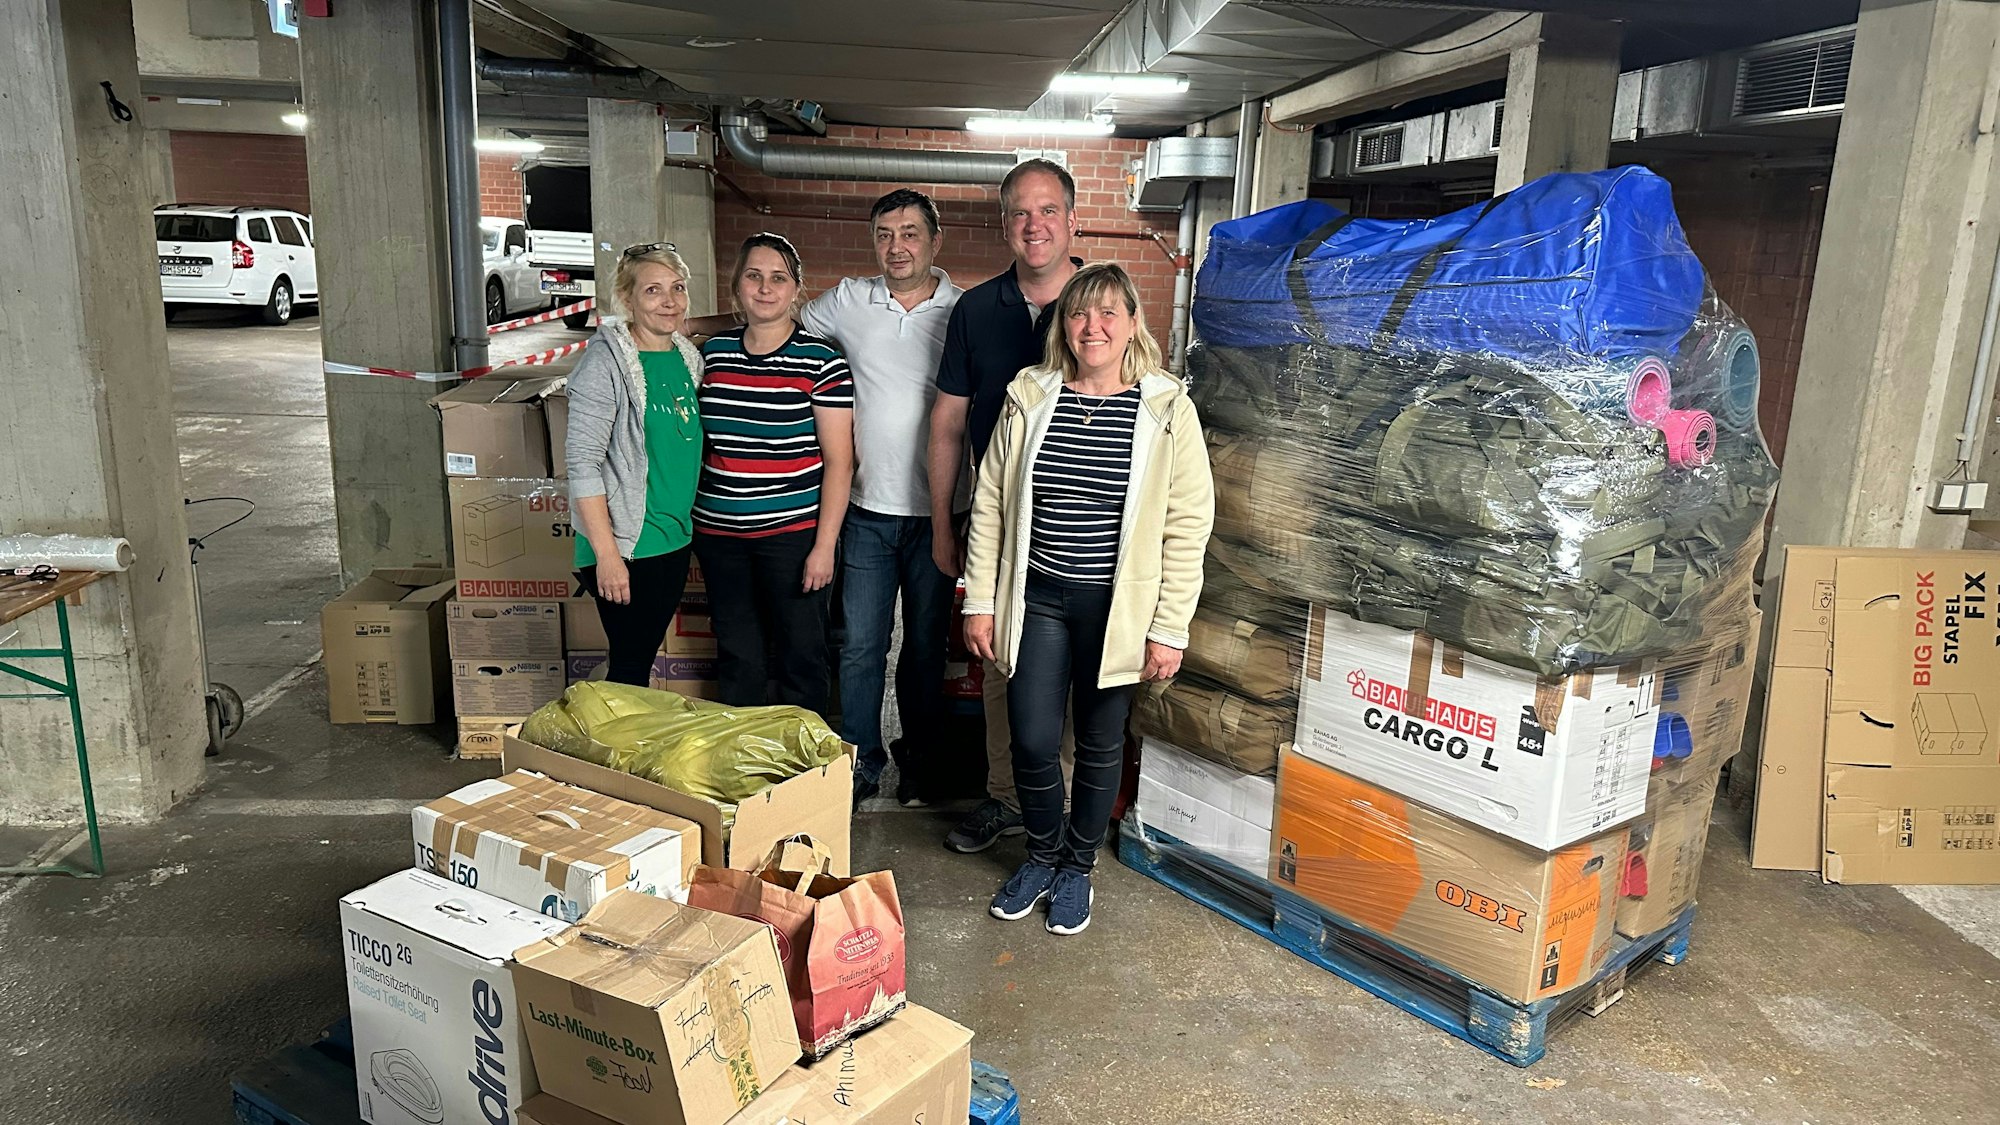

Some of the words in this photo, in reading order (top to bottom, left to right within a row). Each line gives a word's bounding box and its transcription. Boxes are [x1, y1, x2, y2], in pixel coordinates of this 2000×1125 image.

[176, 266, 186, 274] SH
[187, 266, 201, 274] 242
[529, 495, 569, 513] BIG
[460, 580, 569, 598] BAUHAUS
[1915, 571, 1935, 637] PACK
[1964, 571, 1986, 618] FIX
[1943, 594, 1961, 664] STAPEL
[1913, 645, 1932, 686] BIG
[1367, 680, 1497, 741] BAUHAUS
[1363, 707, 1468, 759] CARGO
[1480, 747, 1499, 772] L
[1519, 737, 1543, 750] 45+
[417, 842, 449, 876] TSE
[450, 859, 479, 890] 150
[1435, 879, 1527, 933] OBI
[348, 928, 392, 967] TICCO
[396, 943, 413, 966] 2G
[837, 968, 869, 985] Tradition
[870, 962, 879, 971] seit
[880, 952, 895, 966] 1933
[350, 956, 440, 1014] Toilettensitzerhöhung
[352, 977, 382, 1002] Raised
[382, 988, 406, 1015] Toilet
[407, 1003, 427, 1025] Seat
[468, 979, 510, 1125] drive
[528, 1002, 658, 1065] Last-Minute-Box
